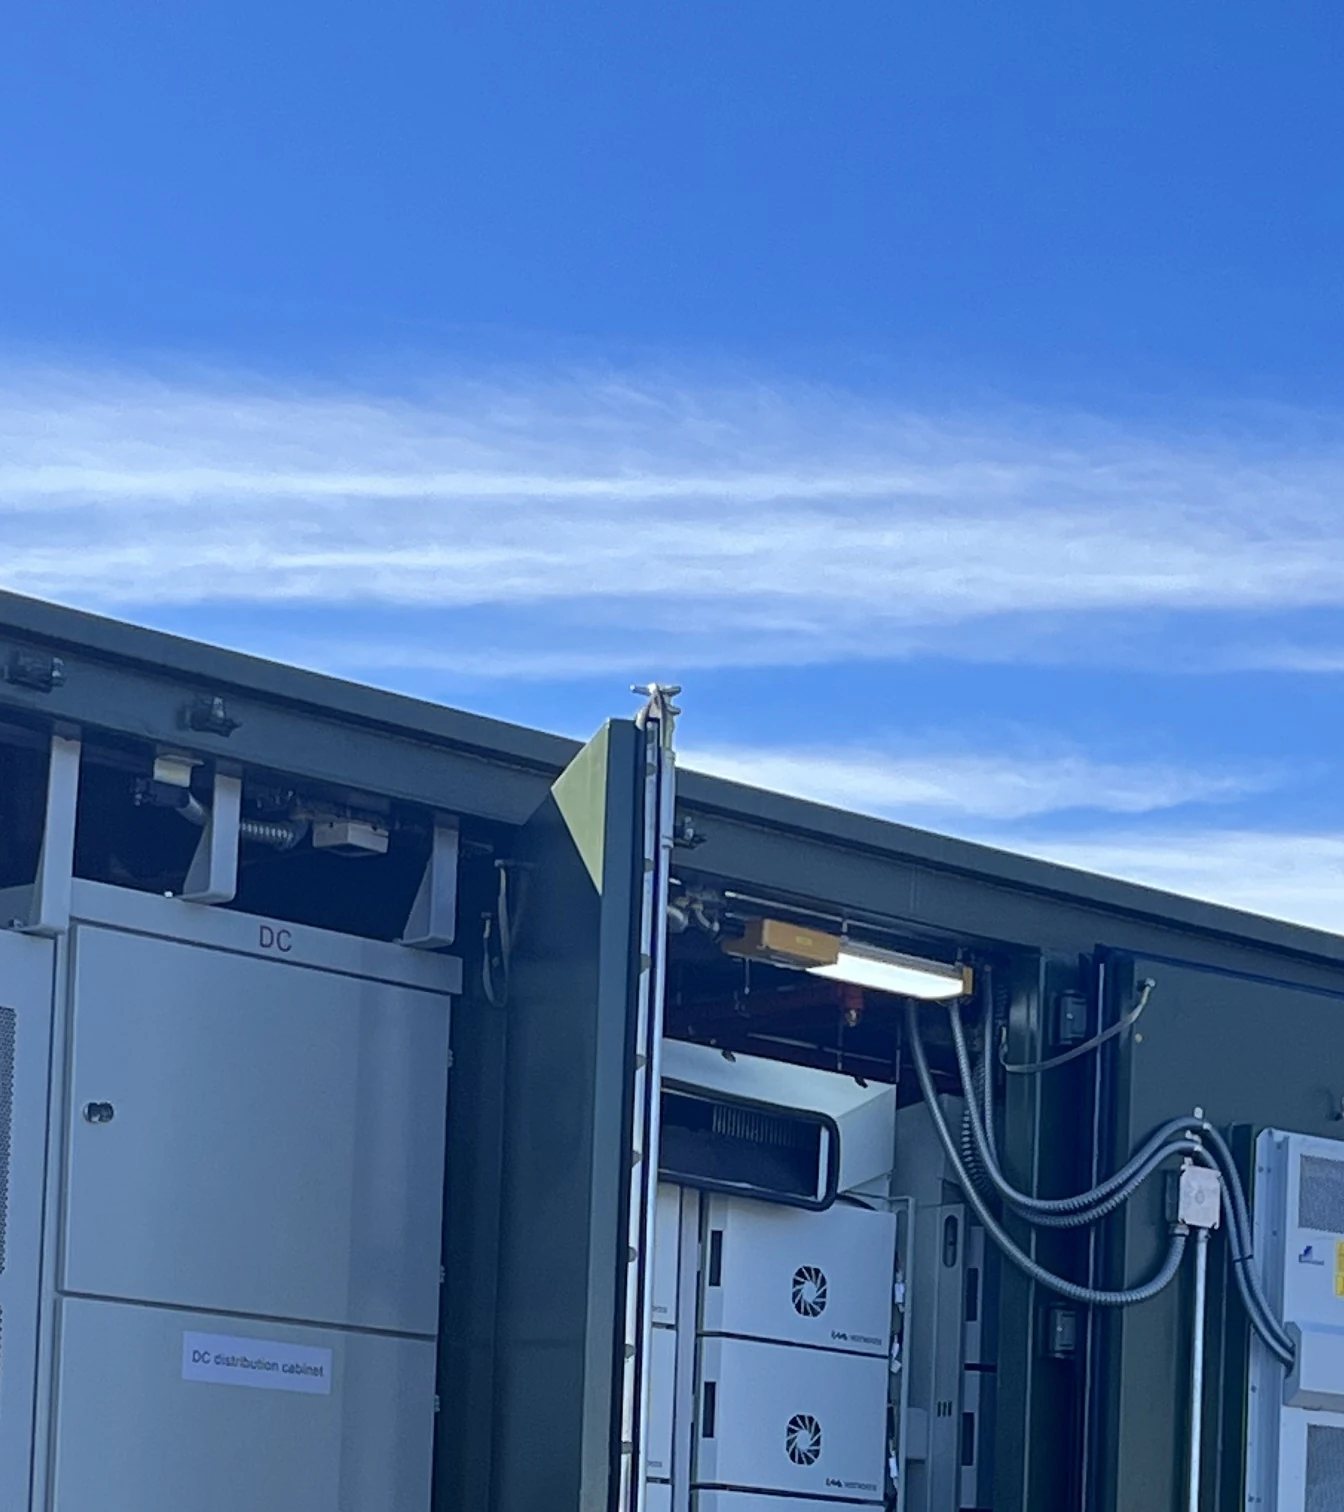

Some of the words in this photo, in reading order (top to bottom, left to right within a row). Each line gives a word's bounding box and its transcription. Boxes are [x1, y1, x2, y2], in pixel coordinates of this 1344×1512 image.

[259, 924, 292, 952] DC
[192, 1350, 211, 1364] DC
[214, 1354, 279, 1372] distribution
[282, 1362, 324, 1377] cabinet
